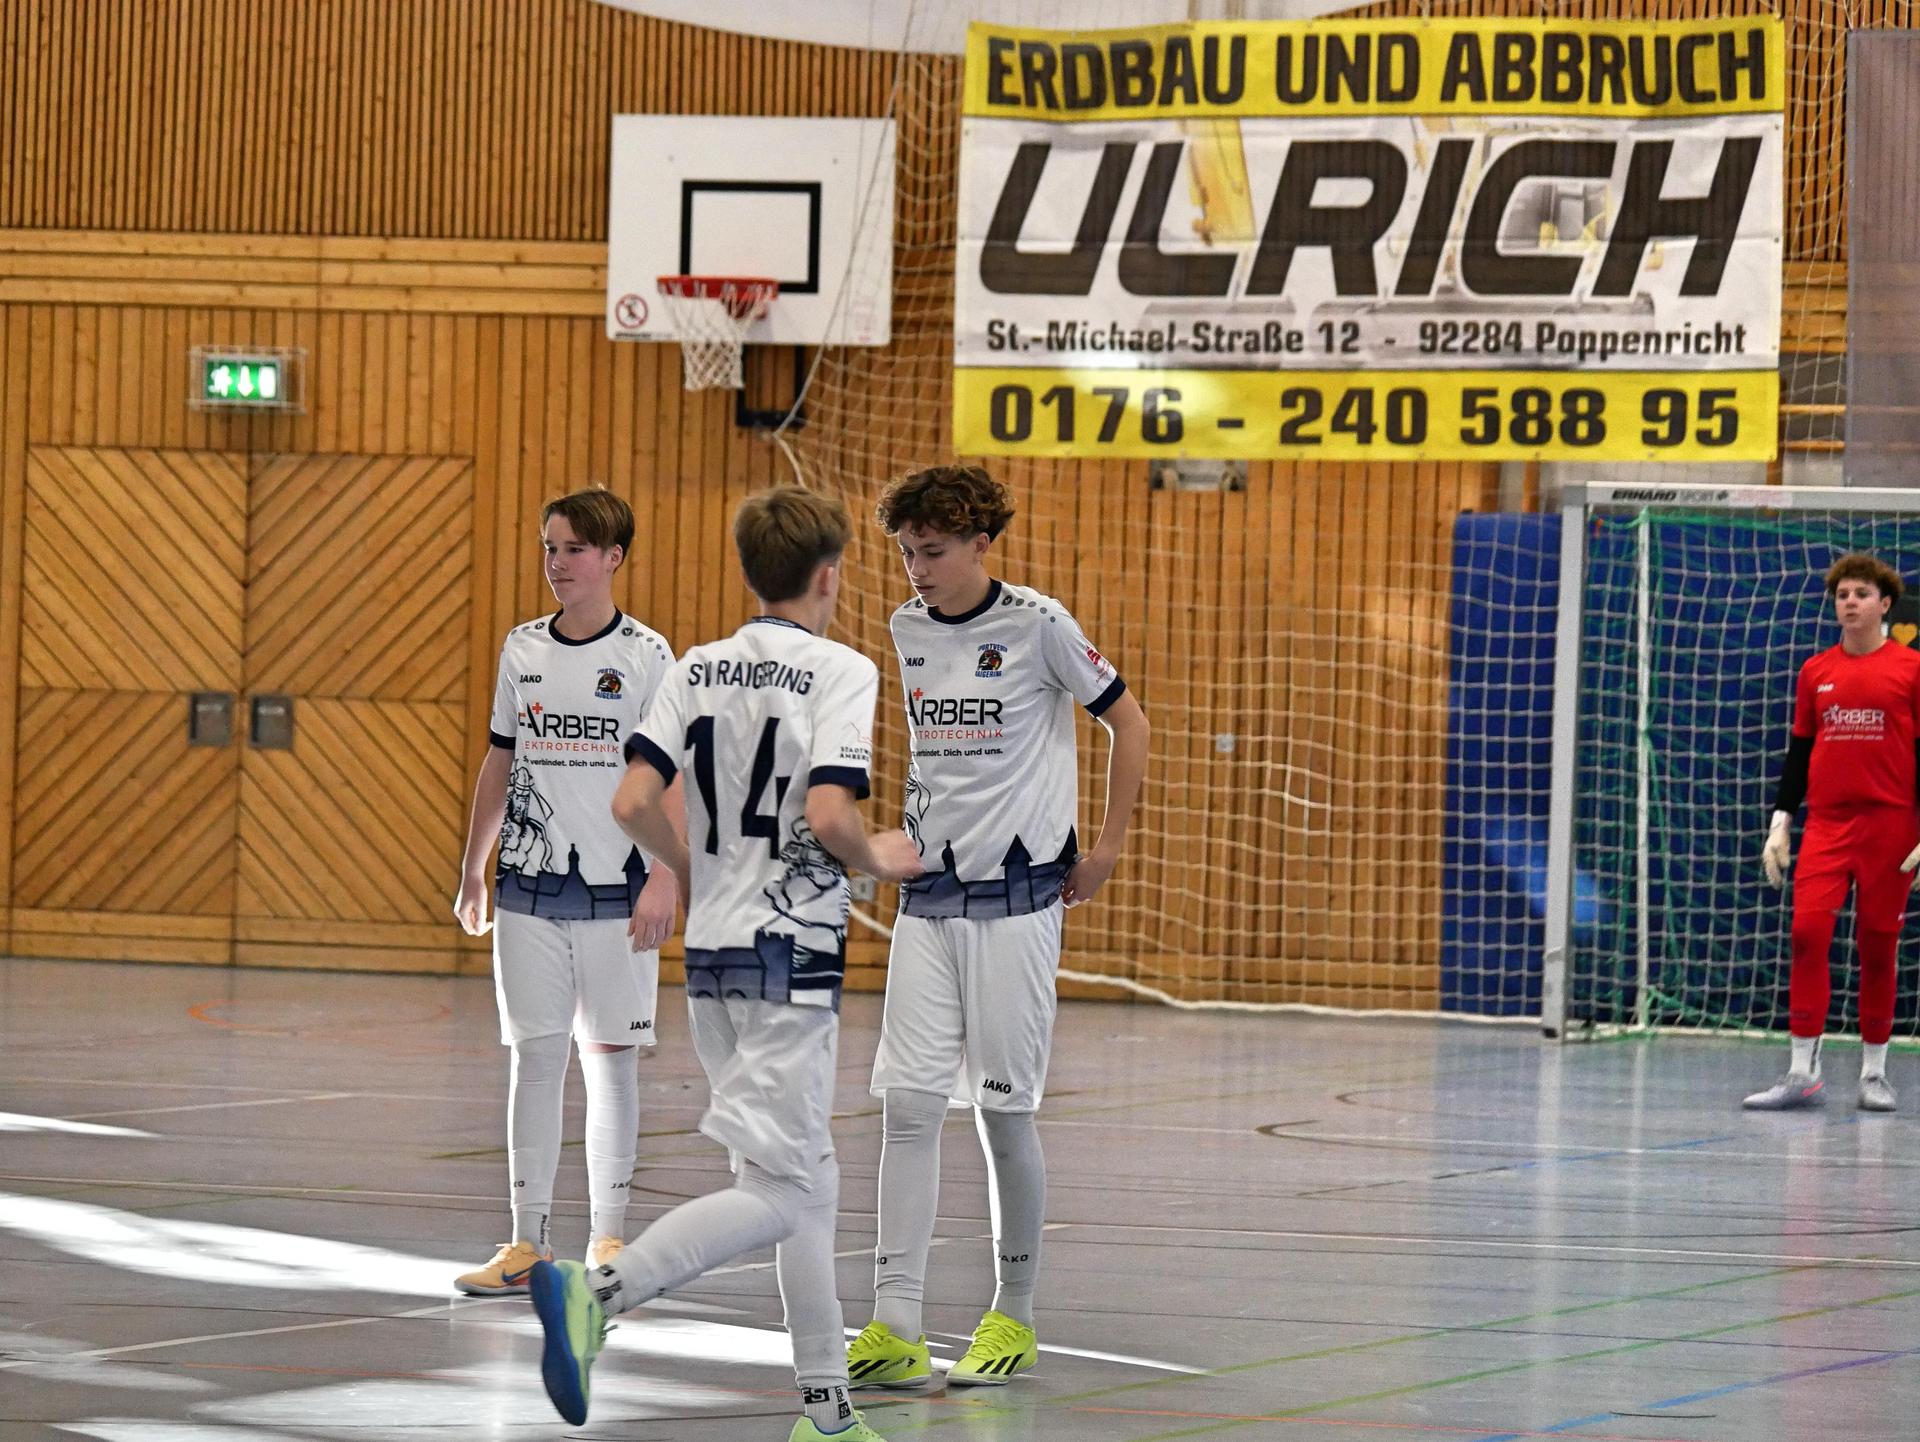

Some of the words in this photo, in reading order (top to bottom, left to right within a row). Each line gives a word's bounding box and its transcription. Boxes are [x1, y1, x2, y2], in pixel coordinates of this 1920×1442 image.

[986, 33, 1248, 112] ERDBAU
[1275, 32, 1420, 105] UND
[1439, 27, 1767, 106] ABBRUCH
[979, 135, 1763, 297] ULRICH
[986, 318, 1305, 354] St.-Michael-Straße
[1317, 320, 1360, 354] 12
[1418, 320, 1523, 354] 92284
[1535, 320, 1747, 363] Poppenricht
[989, 383, 1185, 445] 0176
[1278, 386, 1429, 447] 240
[1459, 386, 1608, 448] 588
[1640, 387, 1740, 448] 95
[519, 674, 542, 684] JAKO
[908, 688, 1004, 726] ARBER
[569, 759, 588, 767] Dich
[589, 760, 605, 768] und
[943, 748, 962, 757] Dich
[964, 747, 982, 756] und
[984, 747, 1003, 756] uns.
[684, 715, 792, 860] 14
[982, 1078, 1012, 1095] JAKO
[998, 1253, 1030, 1264] AKO
